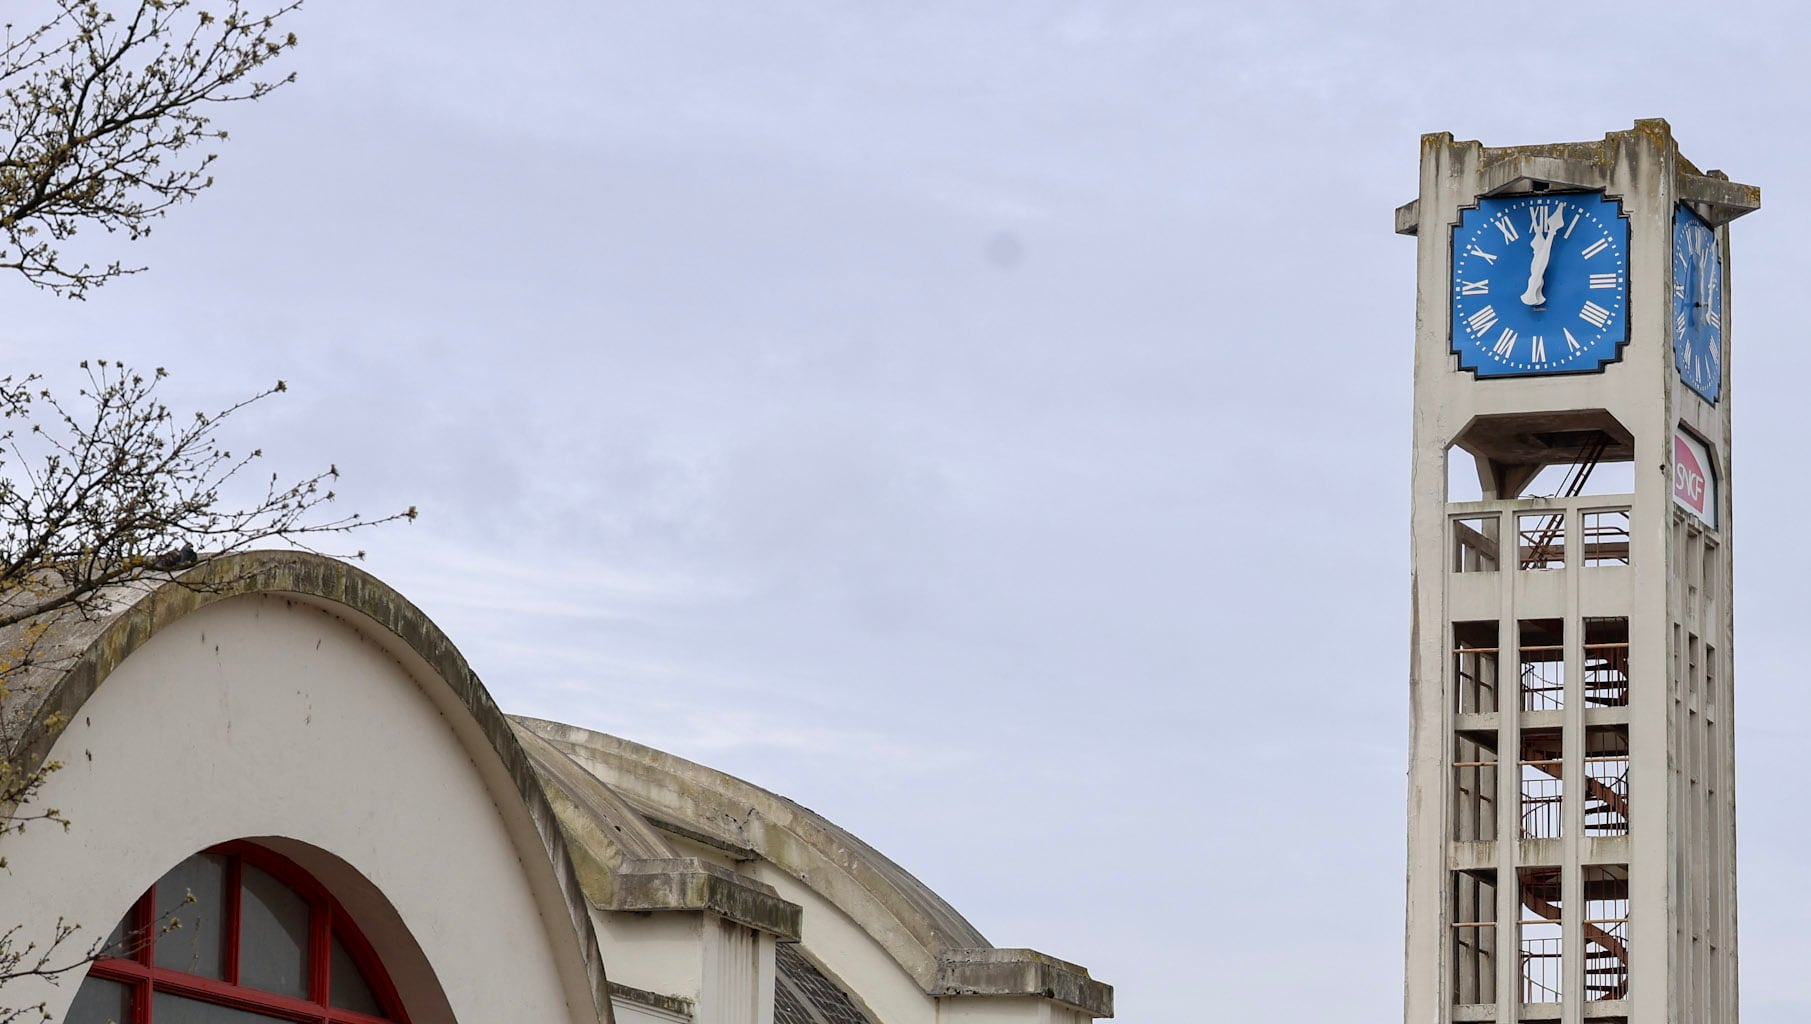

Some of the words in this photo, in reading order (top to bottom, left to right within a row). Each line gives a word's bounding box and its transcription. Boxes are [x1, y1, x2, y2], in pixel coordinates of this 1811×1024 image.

[1495, 215, 1520, 246] XI
[1564, 214, 1580, 239] I
[1471, 245, 1498, 265] X
[1582, 238, 1608, 261] II
[1462, 279, 1489, 296] IX
[1589, 273, 1617, 289] III
[1579, 300, 1610, 328] IIII
[1493, 327, 1518, 359] VII
[1532, 335, 1546, 363] VI
[1563, 327, 1581, 352] V
[1676, 463, 1704, 500] SNCF
